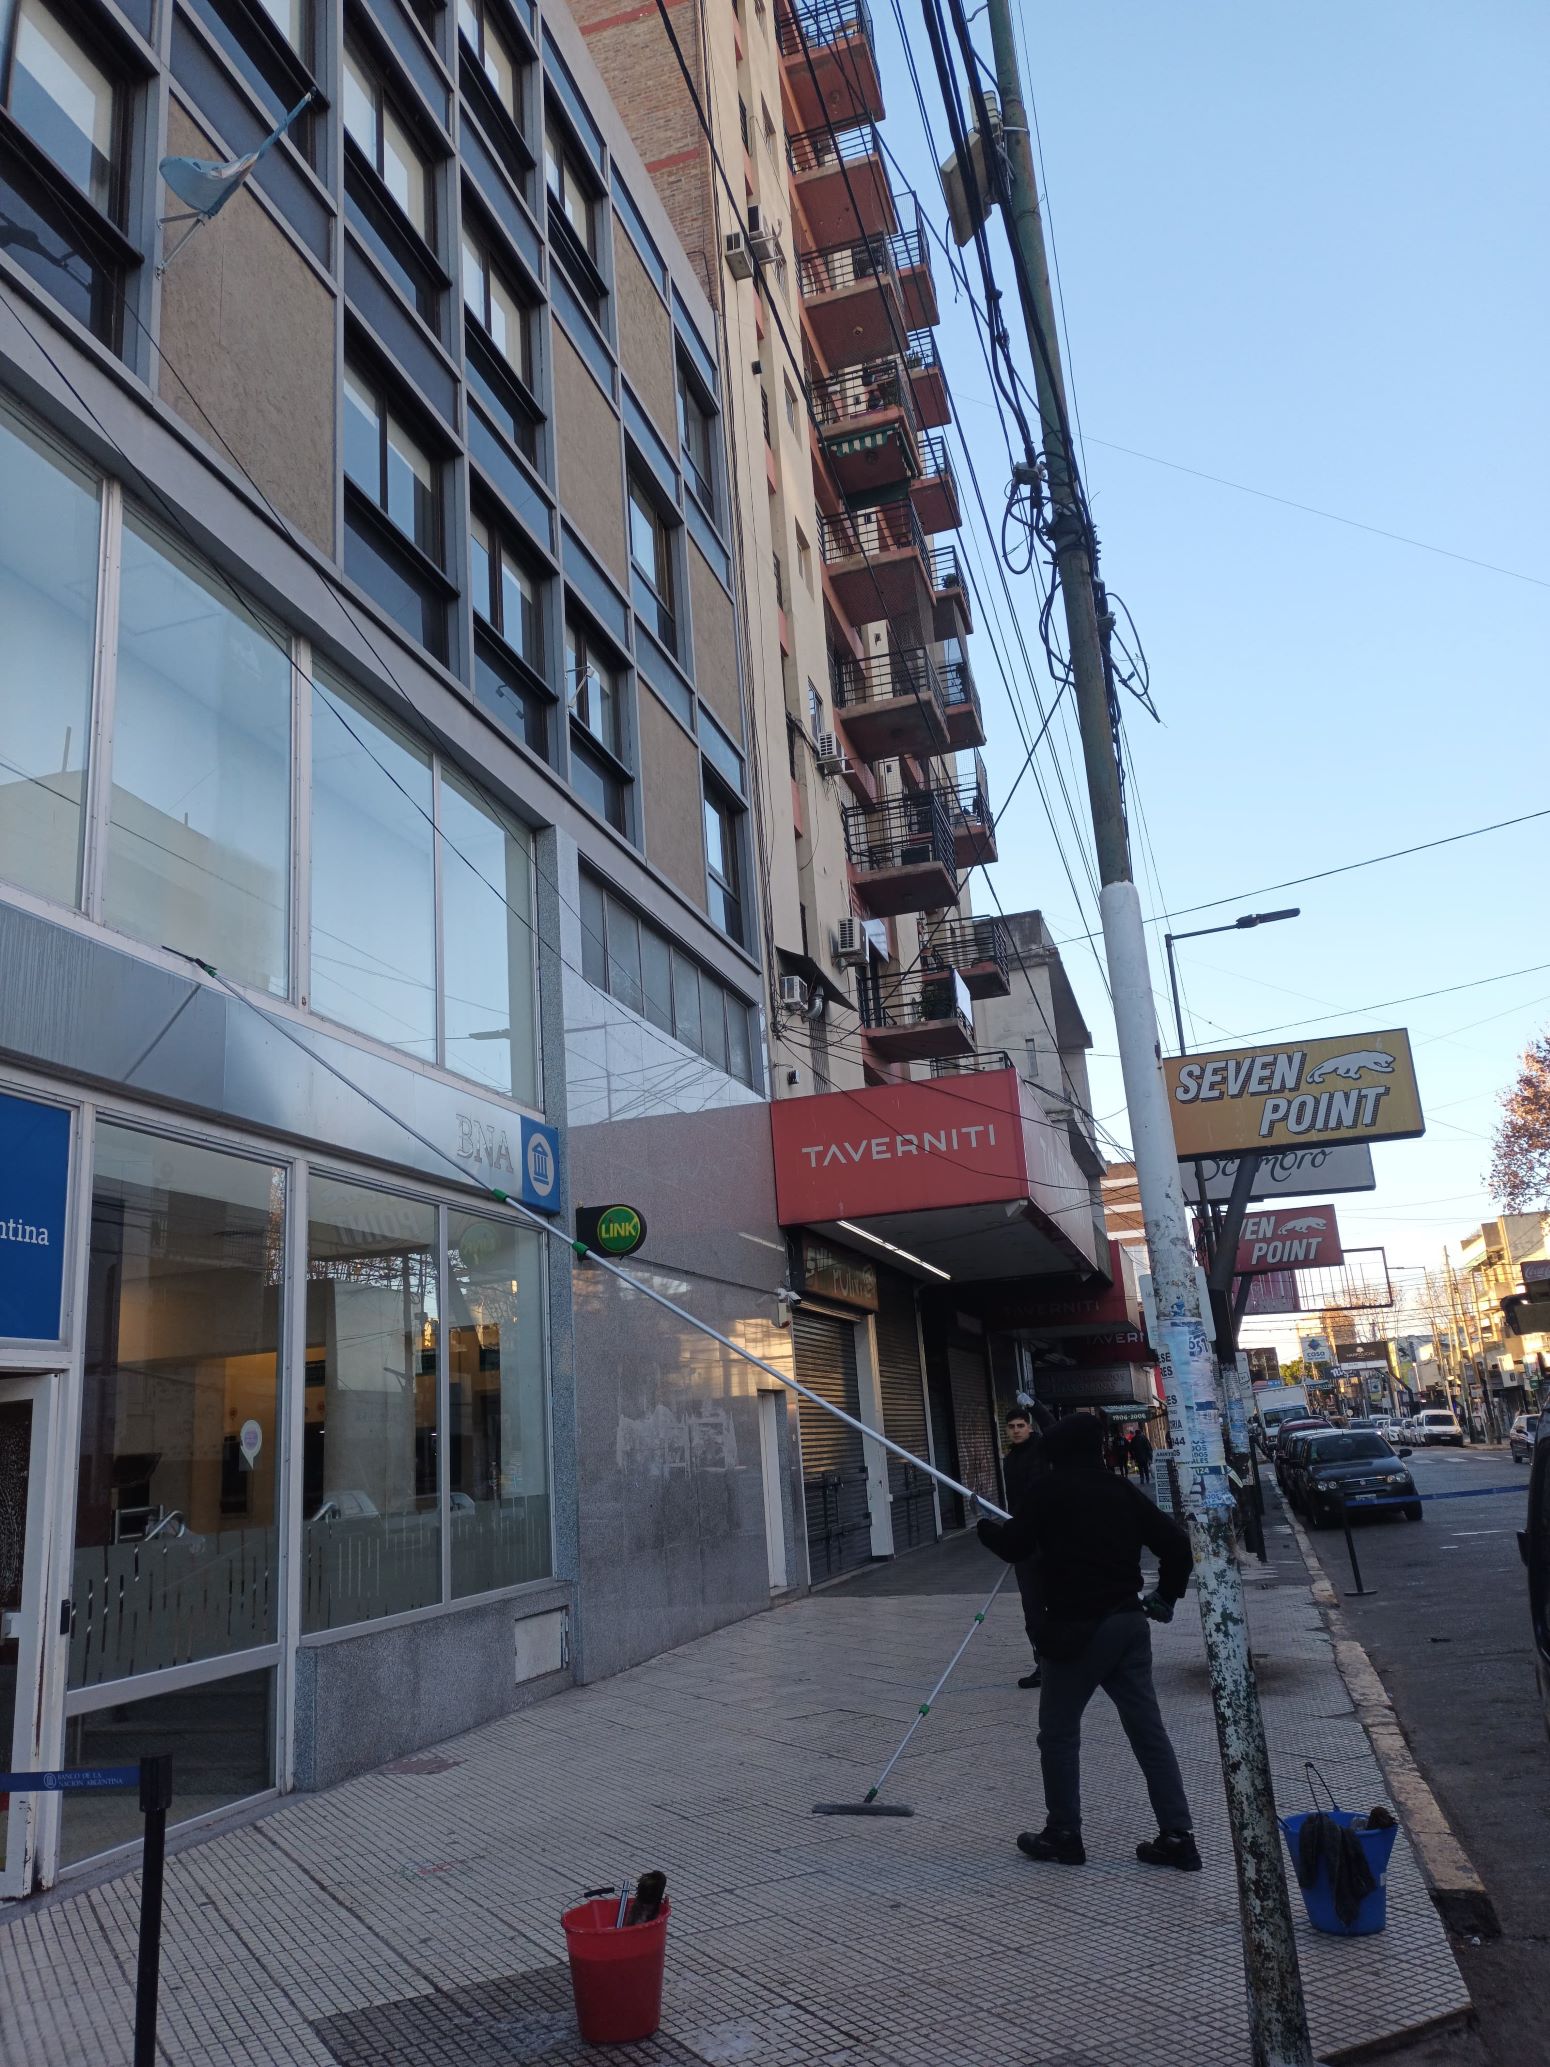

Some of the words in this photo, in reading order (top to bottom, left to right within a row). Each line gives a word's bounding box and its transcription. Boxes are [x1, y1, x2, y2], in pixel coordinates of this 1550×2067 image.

[1175, 1050, 1307, 1104] SEVEN
[1258, 1085, 1391, 1138] POINT
[456, 1113, 514, 1174] BNA
[801, 1123, 996, 1168] TAVERNITI
[601, 1217, 638, 1239] LINK
[1251, 1237, 1323, 1266] POINT
